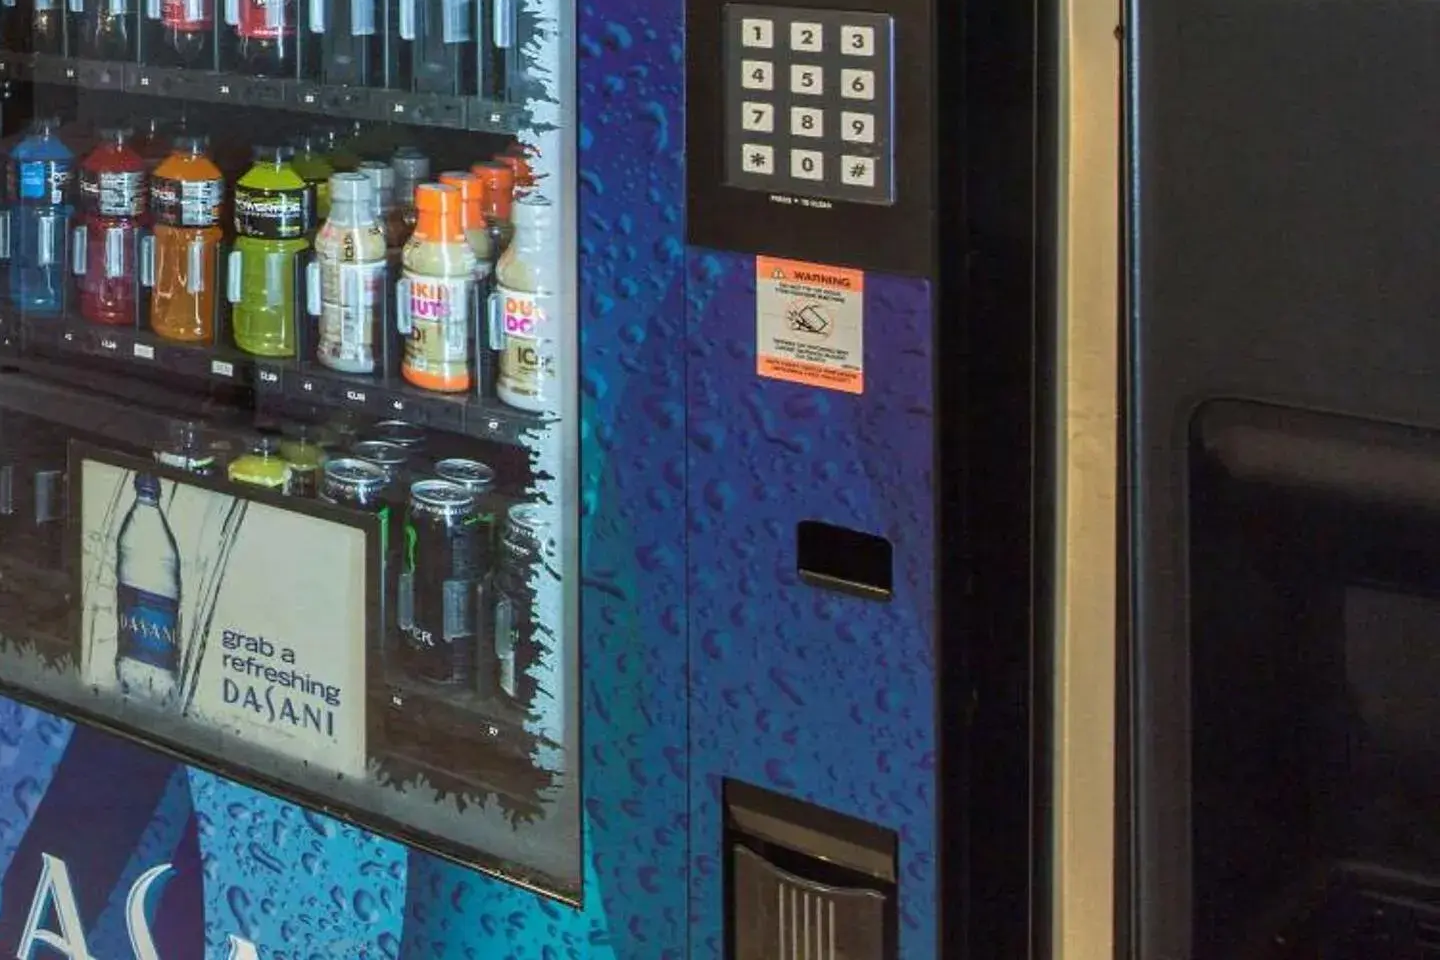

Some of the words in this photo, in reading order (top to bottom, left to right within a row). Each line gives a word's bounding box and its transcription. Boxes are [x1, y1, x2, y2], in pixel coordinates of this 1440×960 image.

[752, 26, 762, 40] 1
[802, 30, 813, 45] 2
[853, 33, 864, 48] 3
[752, 68, 764, 83] 4
[802, 72, 813, 87] 5
[853, 76, 864, 91] 6
[752, 110, 764, 124] 7
[802, 114, 814, 129] 8
[853, 120, 864, 135] 9
[802, 157, 814, 172] 0
[793, 270, 851, 289] WARNING
[222, 629, 275, 657] grab
[280, 648, 295, 664] a
[222, 653, 341, 706] refreshing
[223, 677, 334, 737] DASANI
